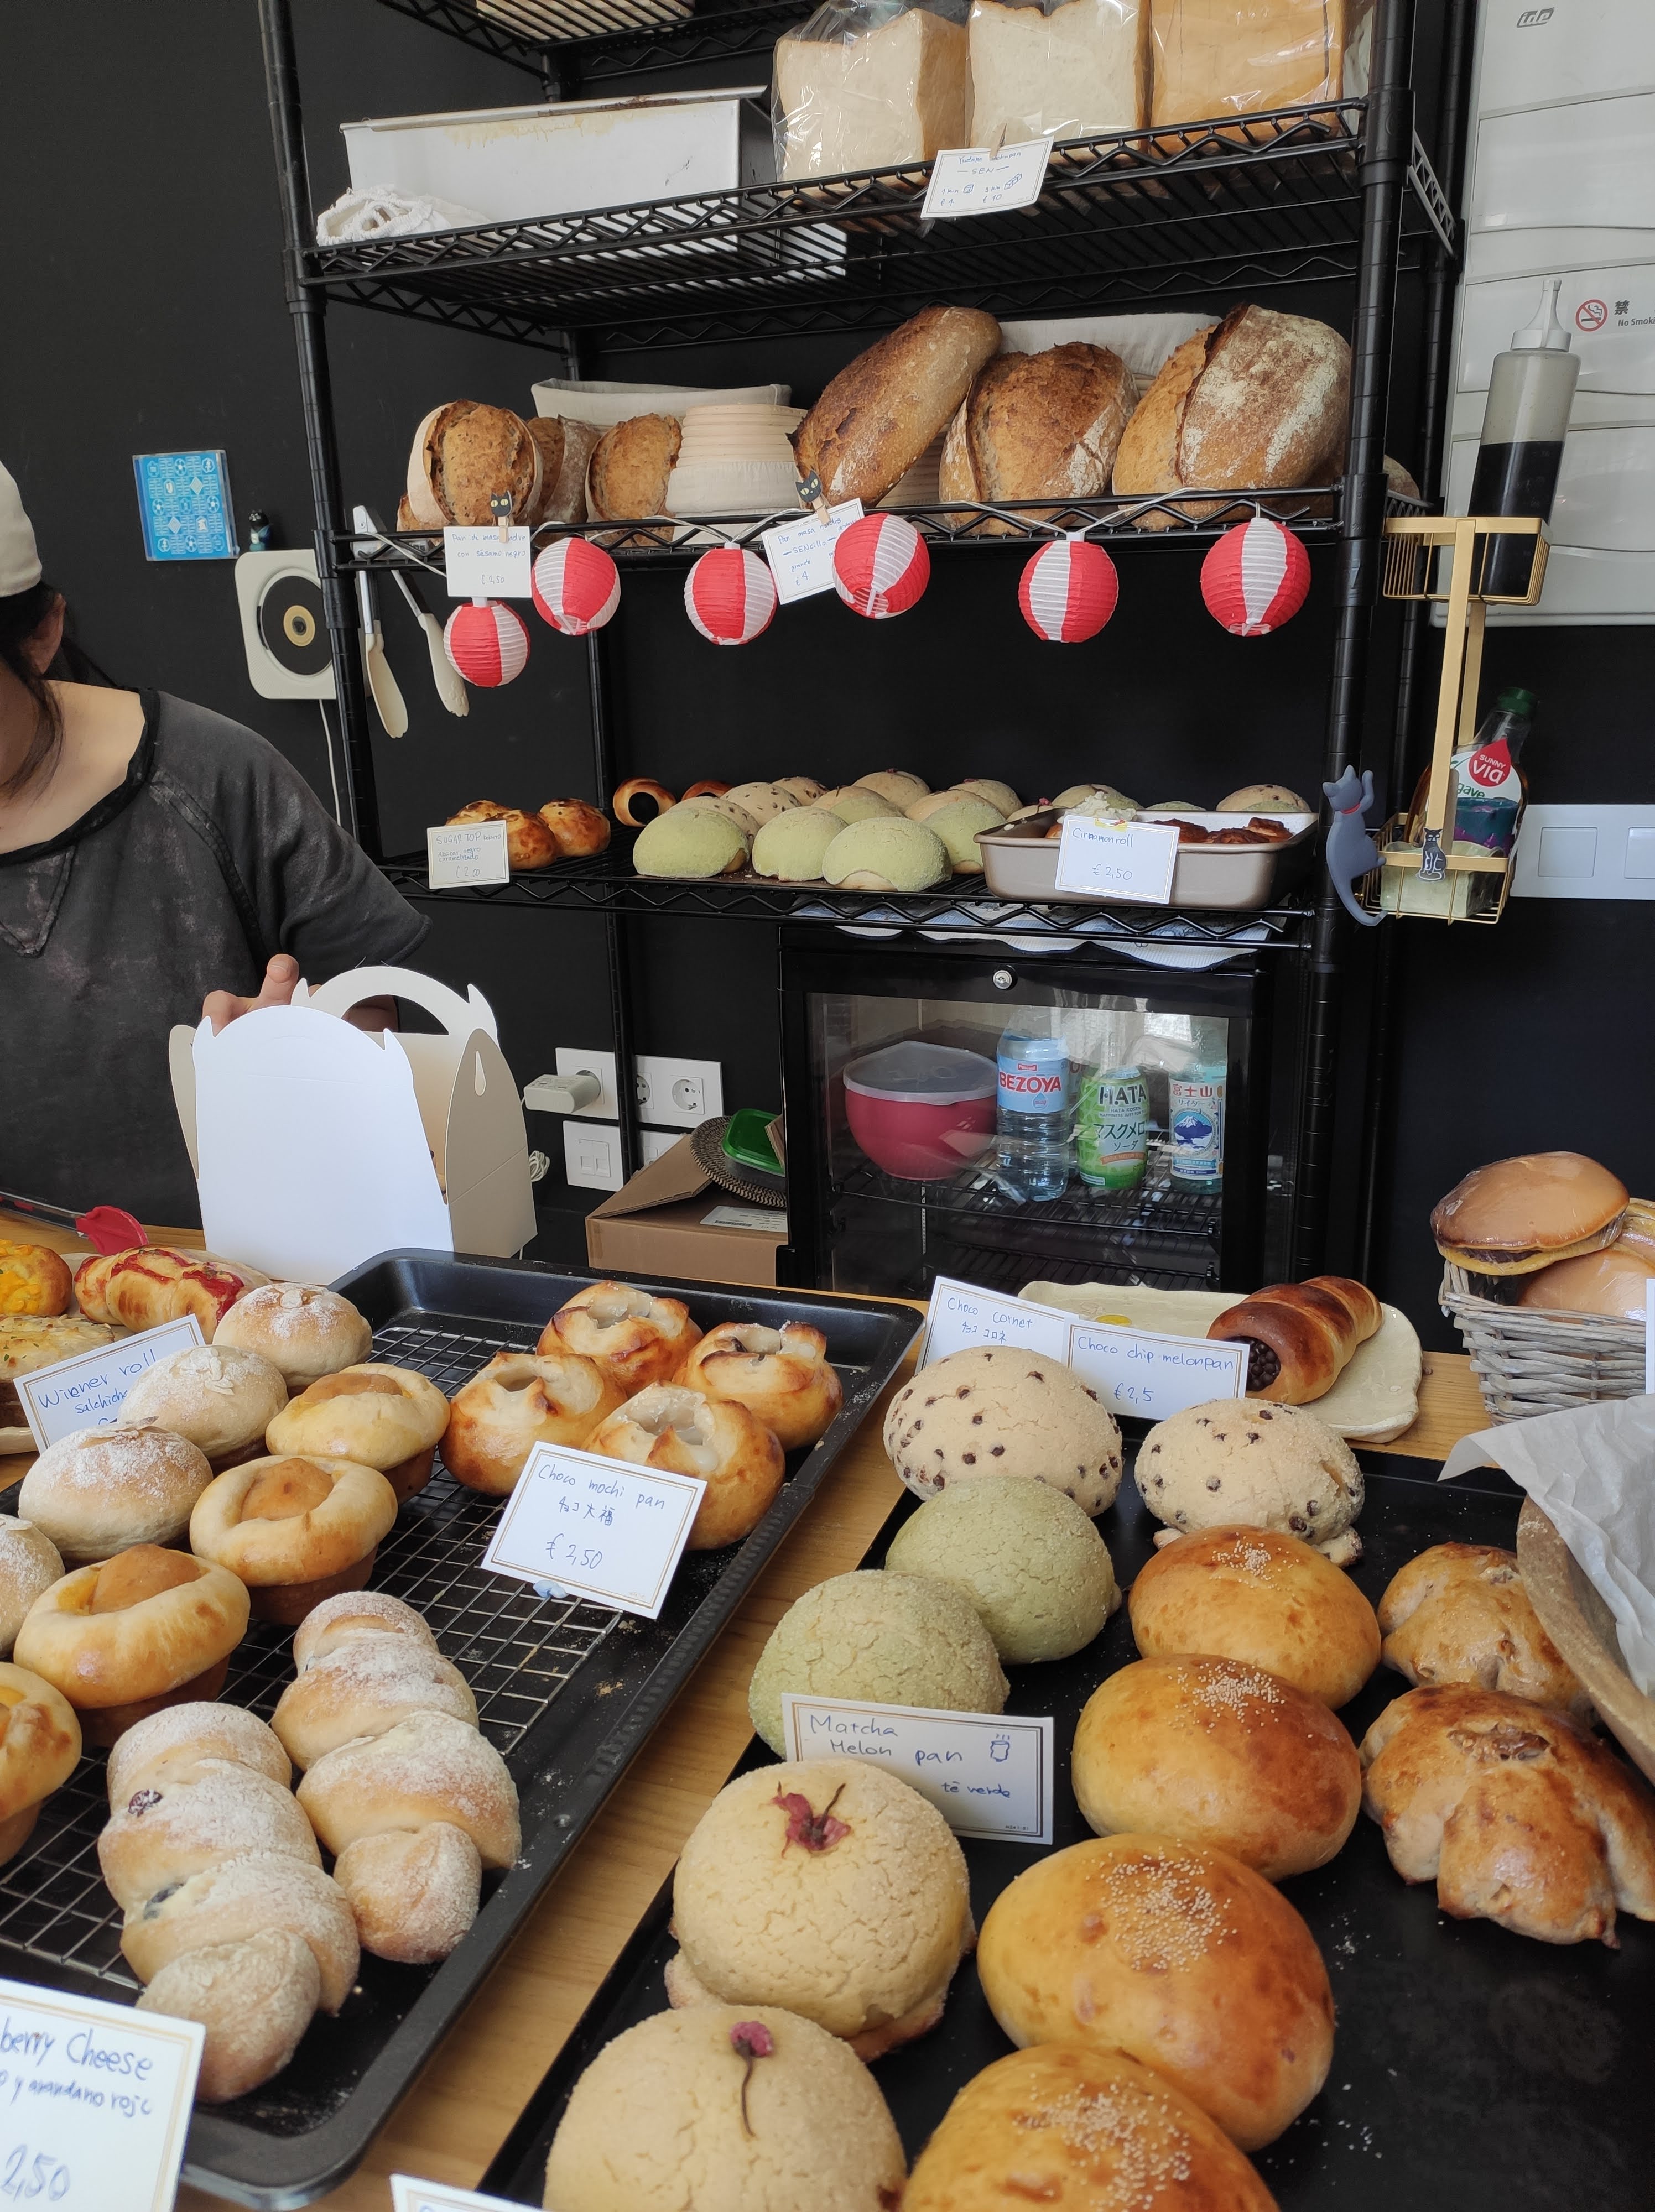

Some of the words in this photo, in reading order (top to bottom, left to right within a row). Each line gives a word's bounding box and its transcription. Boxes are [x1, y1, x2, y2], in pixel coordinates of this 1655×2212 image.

[992, 194, 1002, 202] 10
[452, 534, 466, 544] Pan
[508, 533, 526, 541] adre
[778, 535, 790, 544] Pan
[798, 528, 815, 538] masa
[802, 571, 809, 580] 4
[1479, 754, 1506, 769] SUNNY
[436, 834, 462, 845] SUGAR
[465, 831, 481, 841] TOP
[1092, 863, 1101, 876] €
[1105, 866, 1133, 880] 2,50
[999, 1071, 1062, 1093] BEZOYA
[1173, 1083, 1213, 1098] 富士山
[1093, 1120, 1147, 1140] マスクメロ
[1114, 1139, 1139, 1151] ソーダ
[947, 1297, 979, 1315] Choco
[119, 1349, 156, 1376] roll
[1078, 1336, 1118, 1355] Choco
[1127, 1348, 1154, 1364] chip
[1162, 1353, 1234, 1371] melonpan
[1113, 1383, 1126, 1401] €
[1127, 1386, 1154, 1404] 2,5
[538, 1464, 576, 1485] Choco
[589, 1479, 625, 1498] mochi
[635, 1493, 665, 1510] pan
[545, 1533, 564, 1559] €
[565, 1543, 603, 1569] 2,50
[810, 1714, 899, 1738] Matcha
[914, 1748, 964, 1766] pan
[966, 1783, 1011, 1798] verde
[66, 2028, 154, 2081] Cheese
[1, 2144, 71, 2202] 2,50
